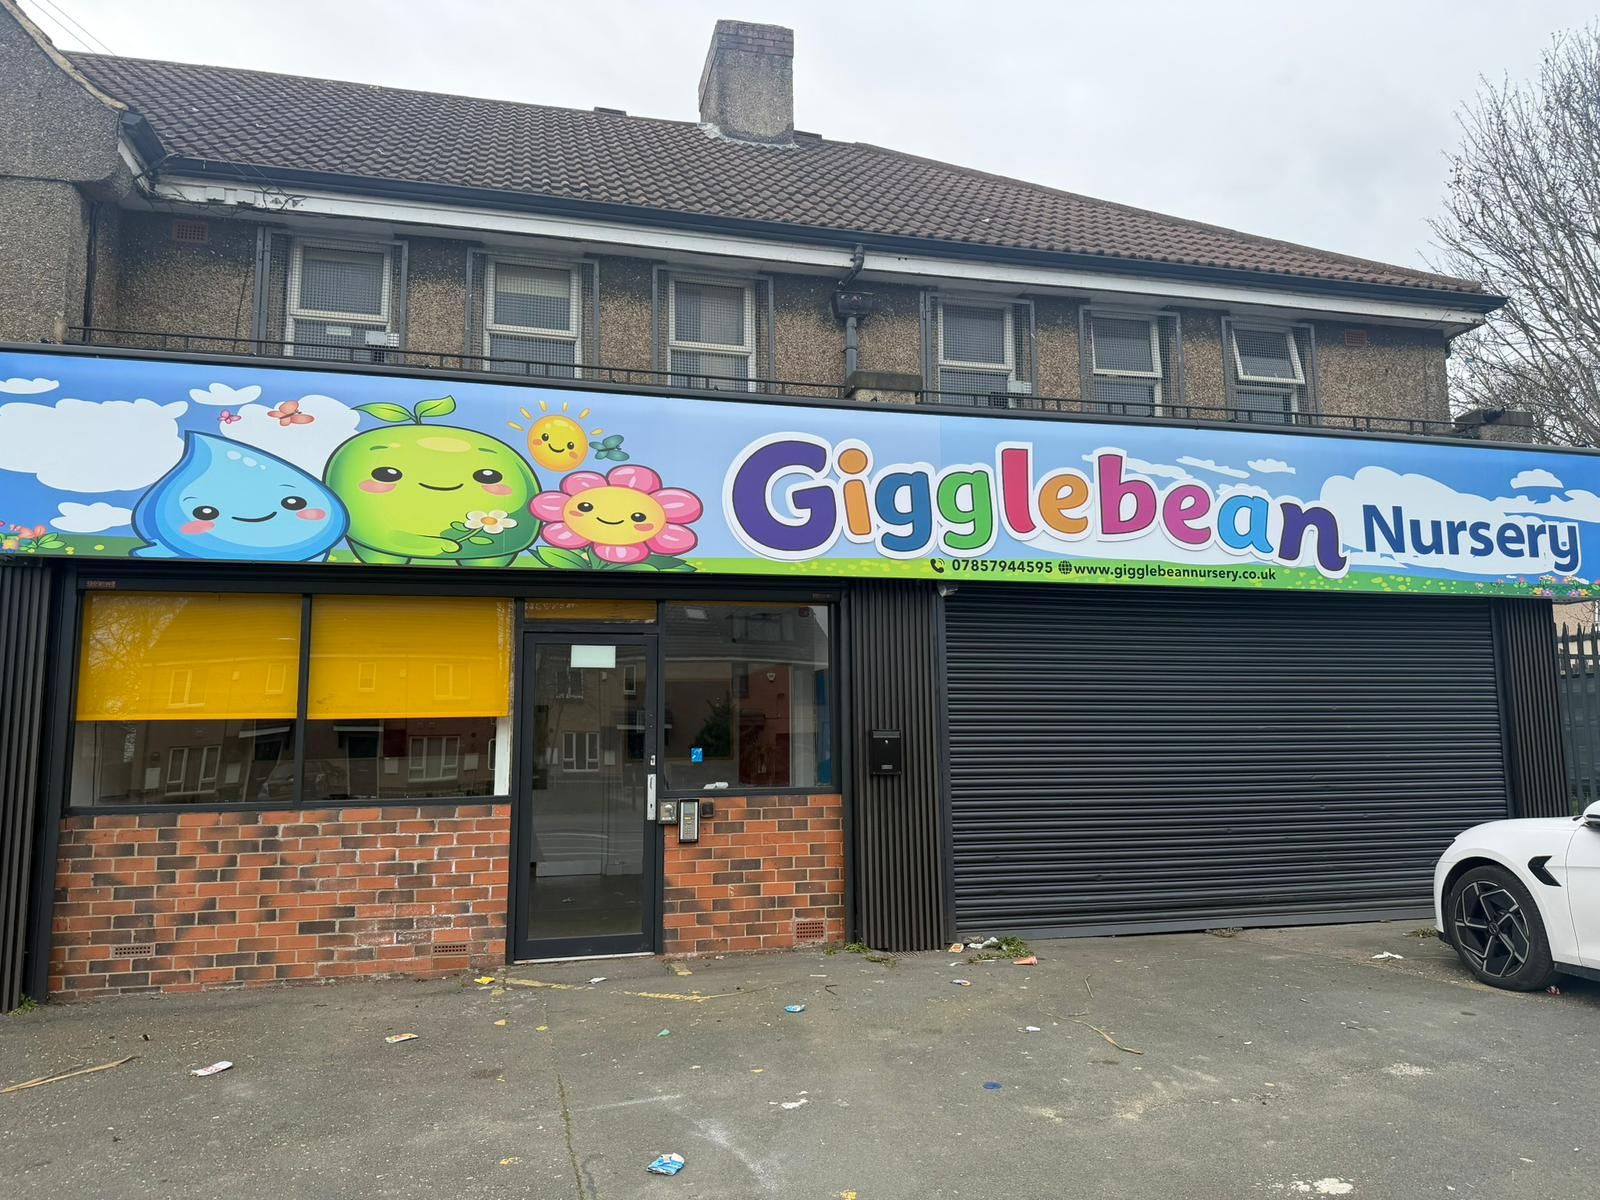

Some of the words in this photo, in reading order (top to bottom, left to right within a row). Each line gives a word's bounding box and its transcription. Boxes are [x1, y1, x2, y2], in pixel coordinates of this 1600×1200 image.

[732, 440, 1347, 571] Gigglebean
[1362, 504, 1579, 571] Nursery
[952, 559, 1053, 573] 07857944595
[1074, 564, 1276, 581] www.gigglebeannursery.co.uk
